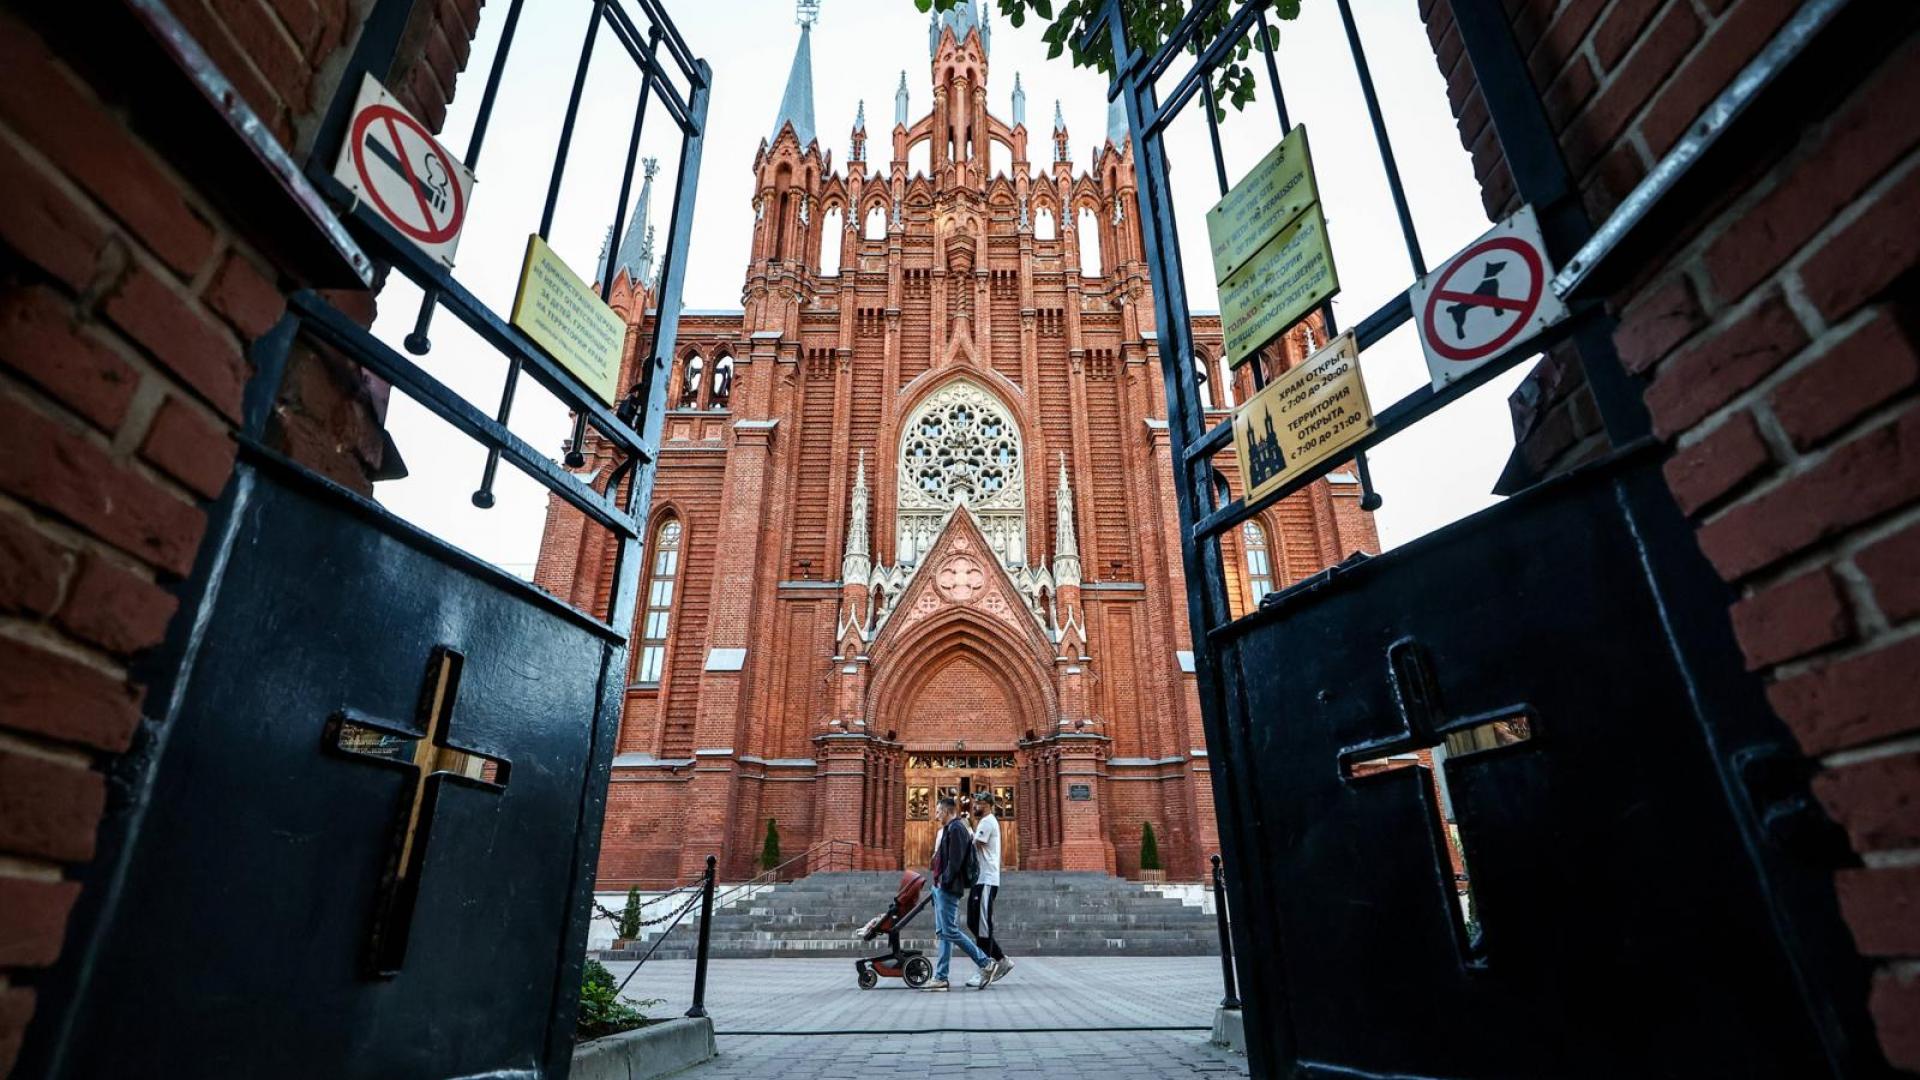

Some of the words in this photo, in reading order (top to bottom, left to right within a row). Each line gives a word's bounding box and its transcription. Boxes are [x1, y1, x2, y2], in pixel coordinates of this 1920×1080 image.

[1261, 170, 1303, 214] PERMISSION
[1227, 305, 1257, 335] ТОЛЬКО
[1239, 294, 1250, 310] НА
[1278, 378, 1305, 403] ХРАМ
[1305, 349, 1347, 384] ОТКРЫТ
[1288, 391, 1308, 410] 7:00
[1307, 382, 1321, 398] до
[1320, 363, 1349, 388] 20:00
[1288, 385, 1351, 434] ТЕРРИТОРИЯ
[1298, 404, 1345, 443] ОТКРЫТА
[1297, 437, 1317, 457] 7:00
[1318, 429, 1332, 445] до
[1332, 410, 1362, 436] 21:00
